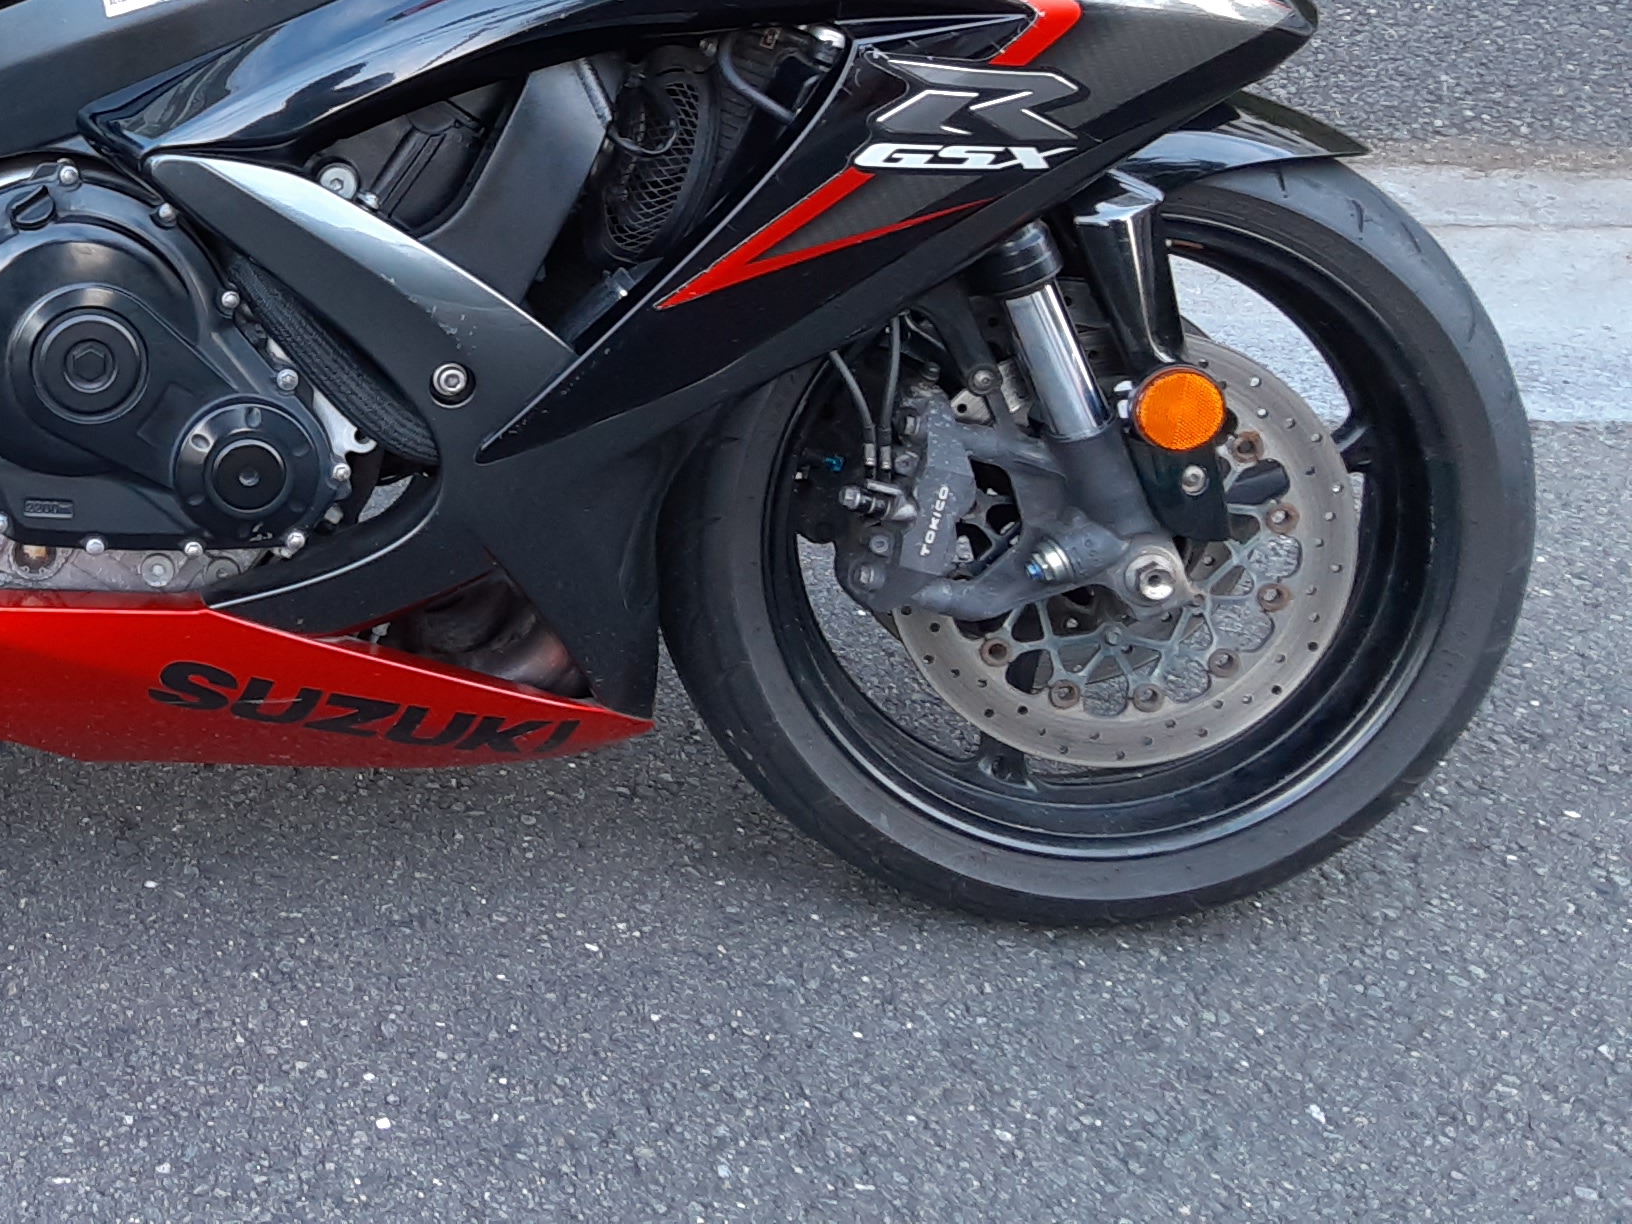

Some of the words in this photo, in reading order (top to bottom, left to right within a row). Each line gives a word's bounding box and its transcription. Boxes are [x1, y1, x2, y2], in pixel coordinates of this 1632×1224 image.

[854, 142, 1078, 170] GSX
[919, 485, 950, 556] TOKICO
[148, 661, 580, 754] SUZUKI
